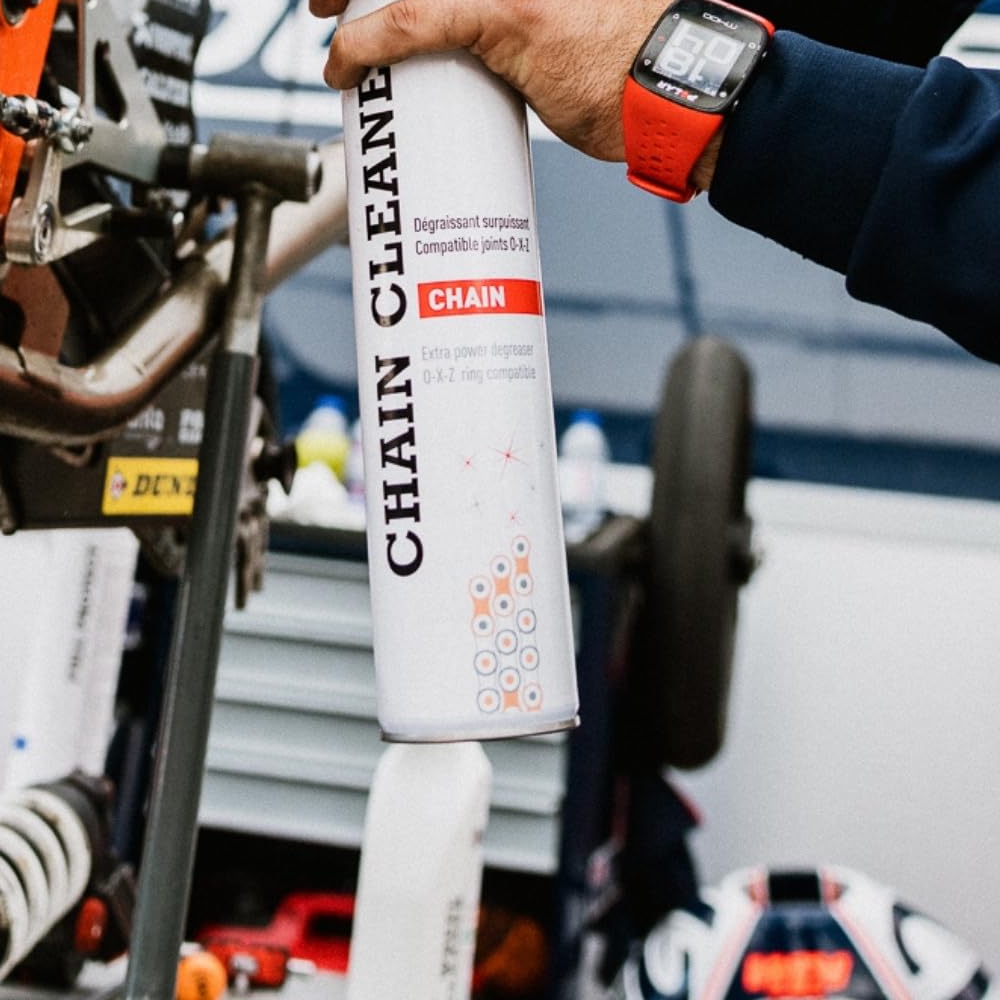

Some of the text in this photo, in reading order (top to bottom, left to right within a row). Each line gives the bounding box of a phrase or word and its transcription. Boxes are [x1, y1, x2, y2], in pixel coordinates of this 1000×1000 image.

[656, 80, 699, 102] POLAR
[414, 214, 530, 234] Dégraissant surpuissant
[415, 237, 479, 256] Compatible
[481, 236, 509, 254] joints
[428, 285, 506, 311] CHAIN
[358, 65, 425, 578] CHAIN CLEANE
[422, 341, 534, 362] Extra power degreaser
[461, 366, 483, 384] ring
[486, 363, 537, 382] compatible
